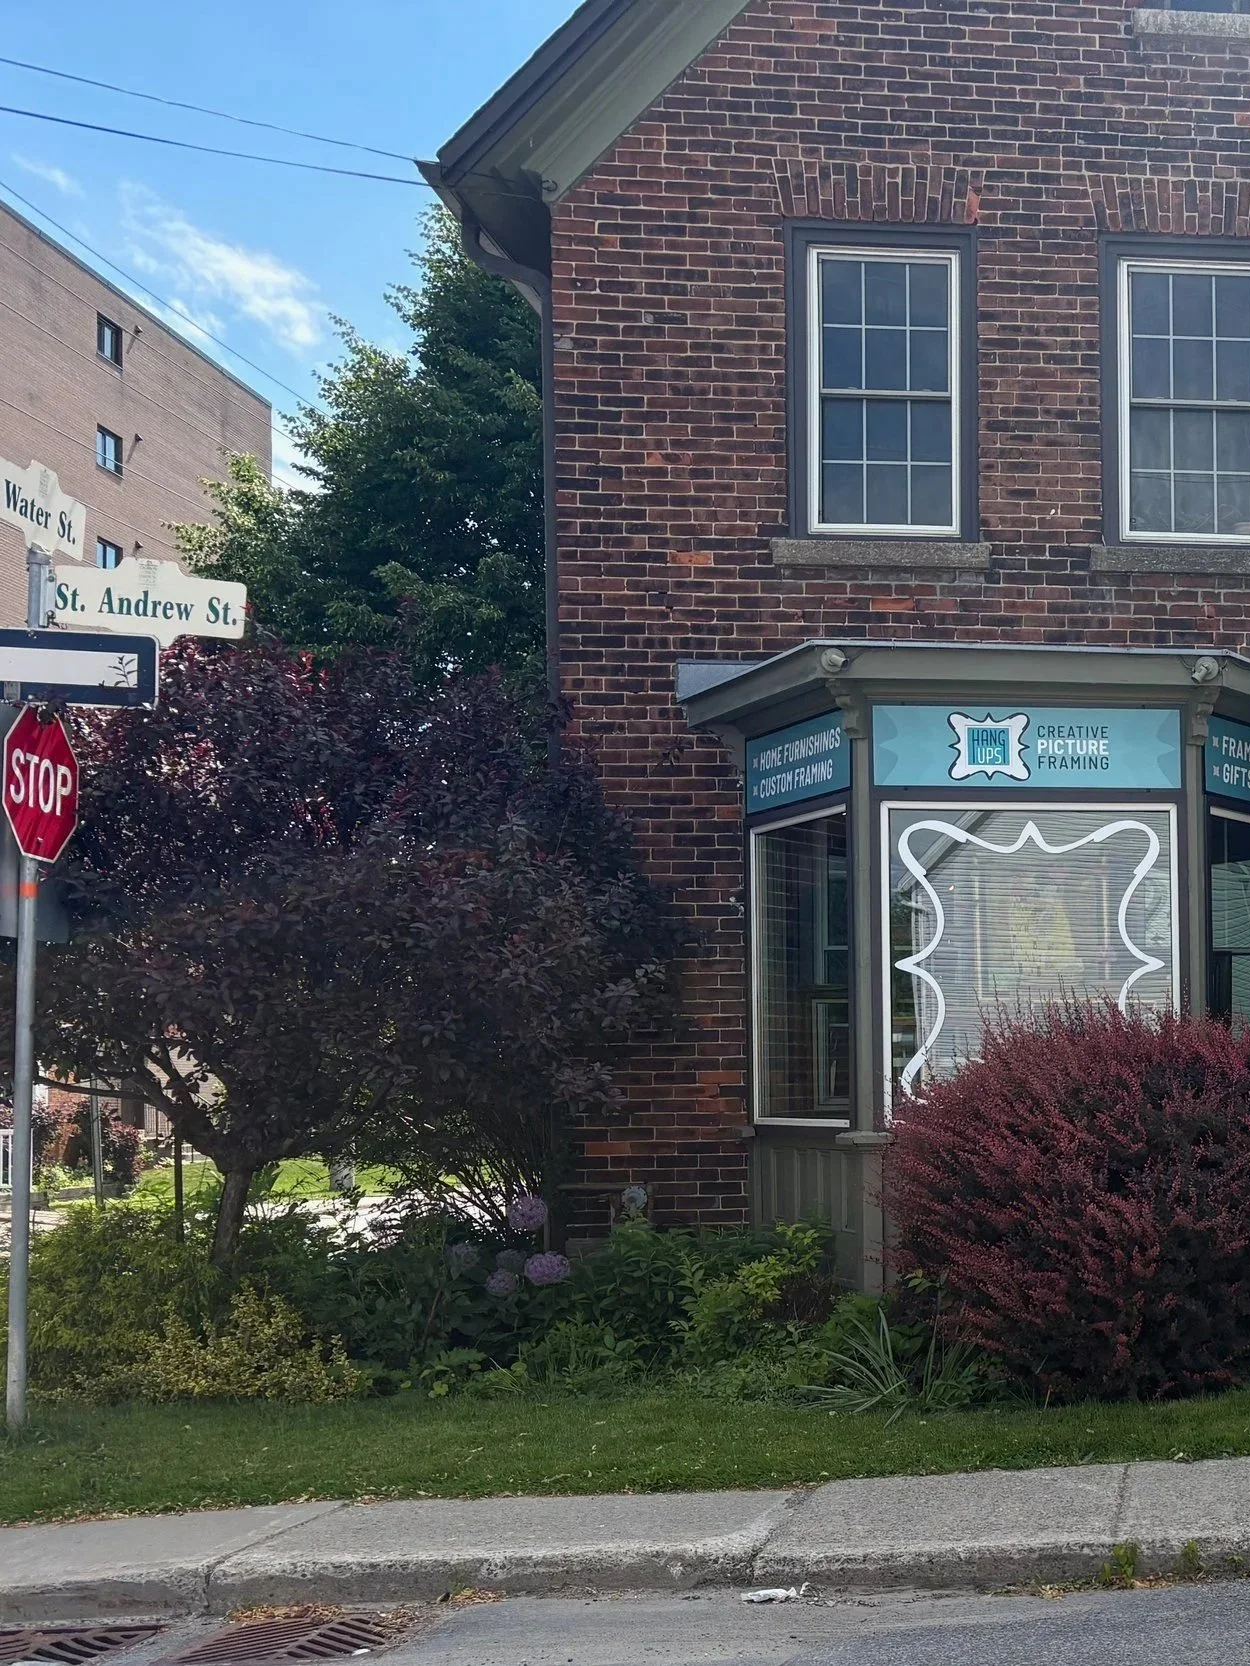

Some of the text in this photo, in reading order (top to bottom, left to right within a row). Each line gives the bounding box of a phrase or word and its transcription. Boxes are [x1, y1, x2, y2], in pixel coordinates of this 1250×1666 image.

[5, 479, 51, 529] Water
[58, 511, 76, 544] St.
[55, 583, 237, 625] St. Andrew St.
[760, 727, 841, 771] HOME FURNISHINGS
[972, 729, 1006, 762] HANG
[1037, 725, 1109, 739] CREATIVE
[1037, 739, 1109, 755] PICTURE
[977, 747, 1001, 763] UPS
[1037, 755, 1109, 770] FRAMING
[10, 748, 72, 816] STOP
[760, 759, 833, 798] CUSTOM FRAMING
